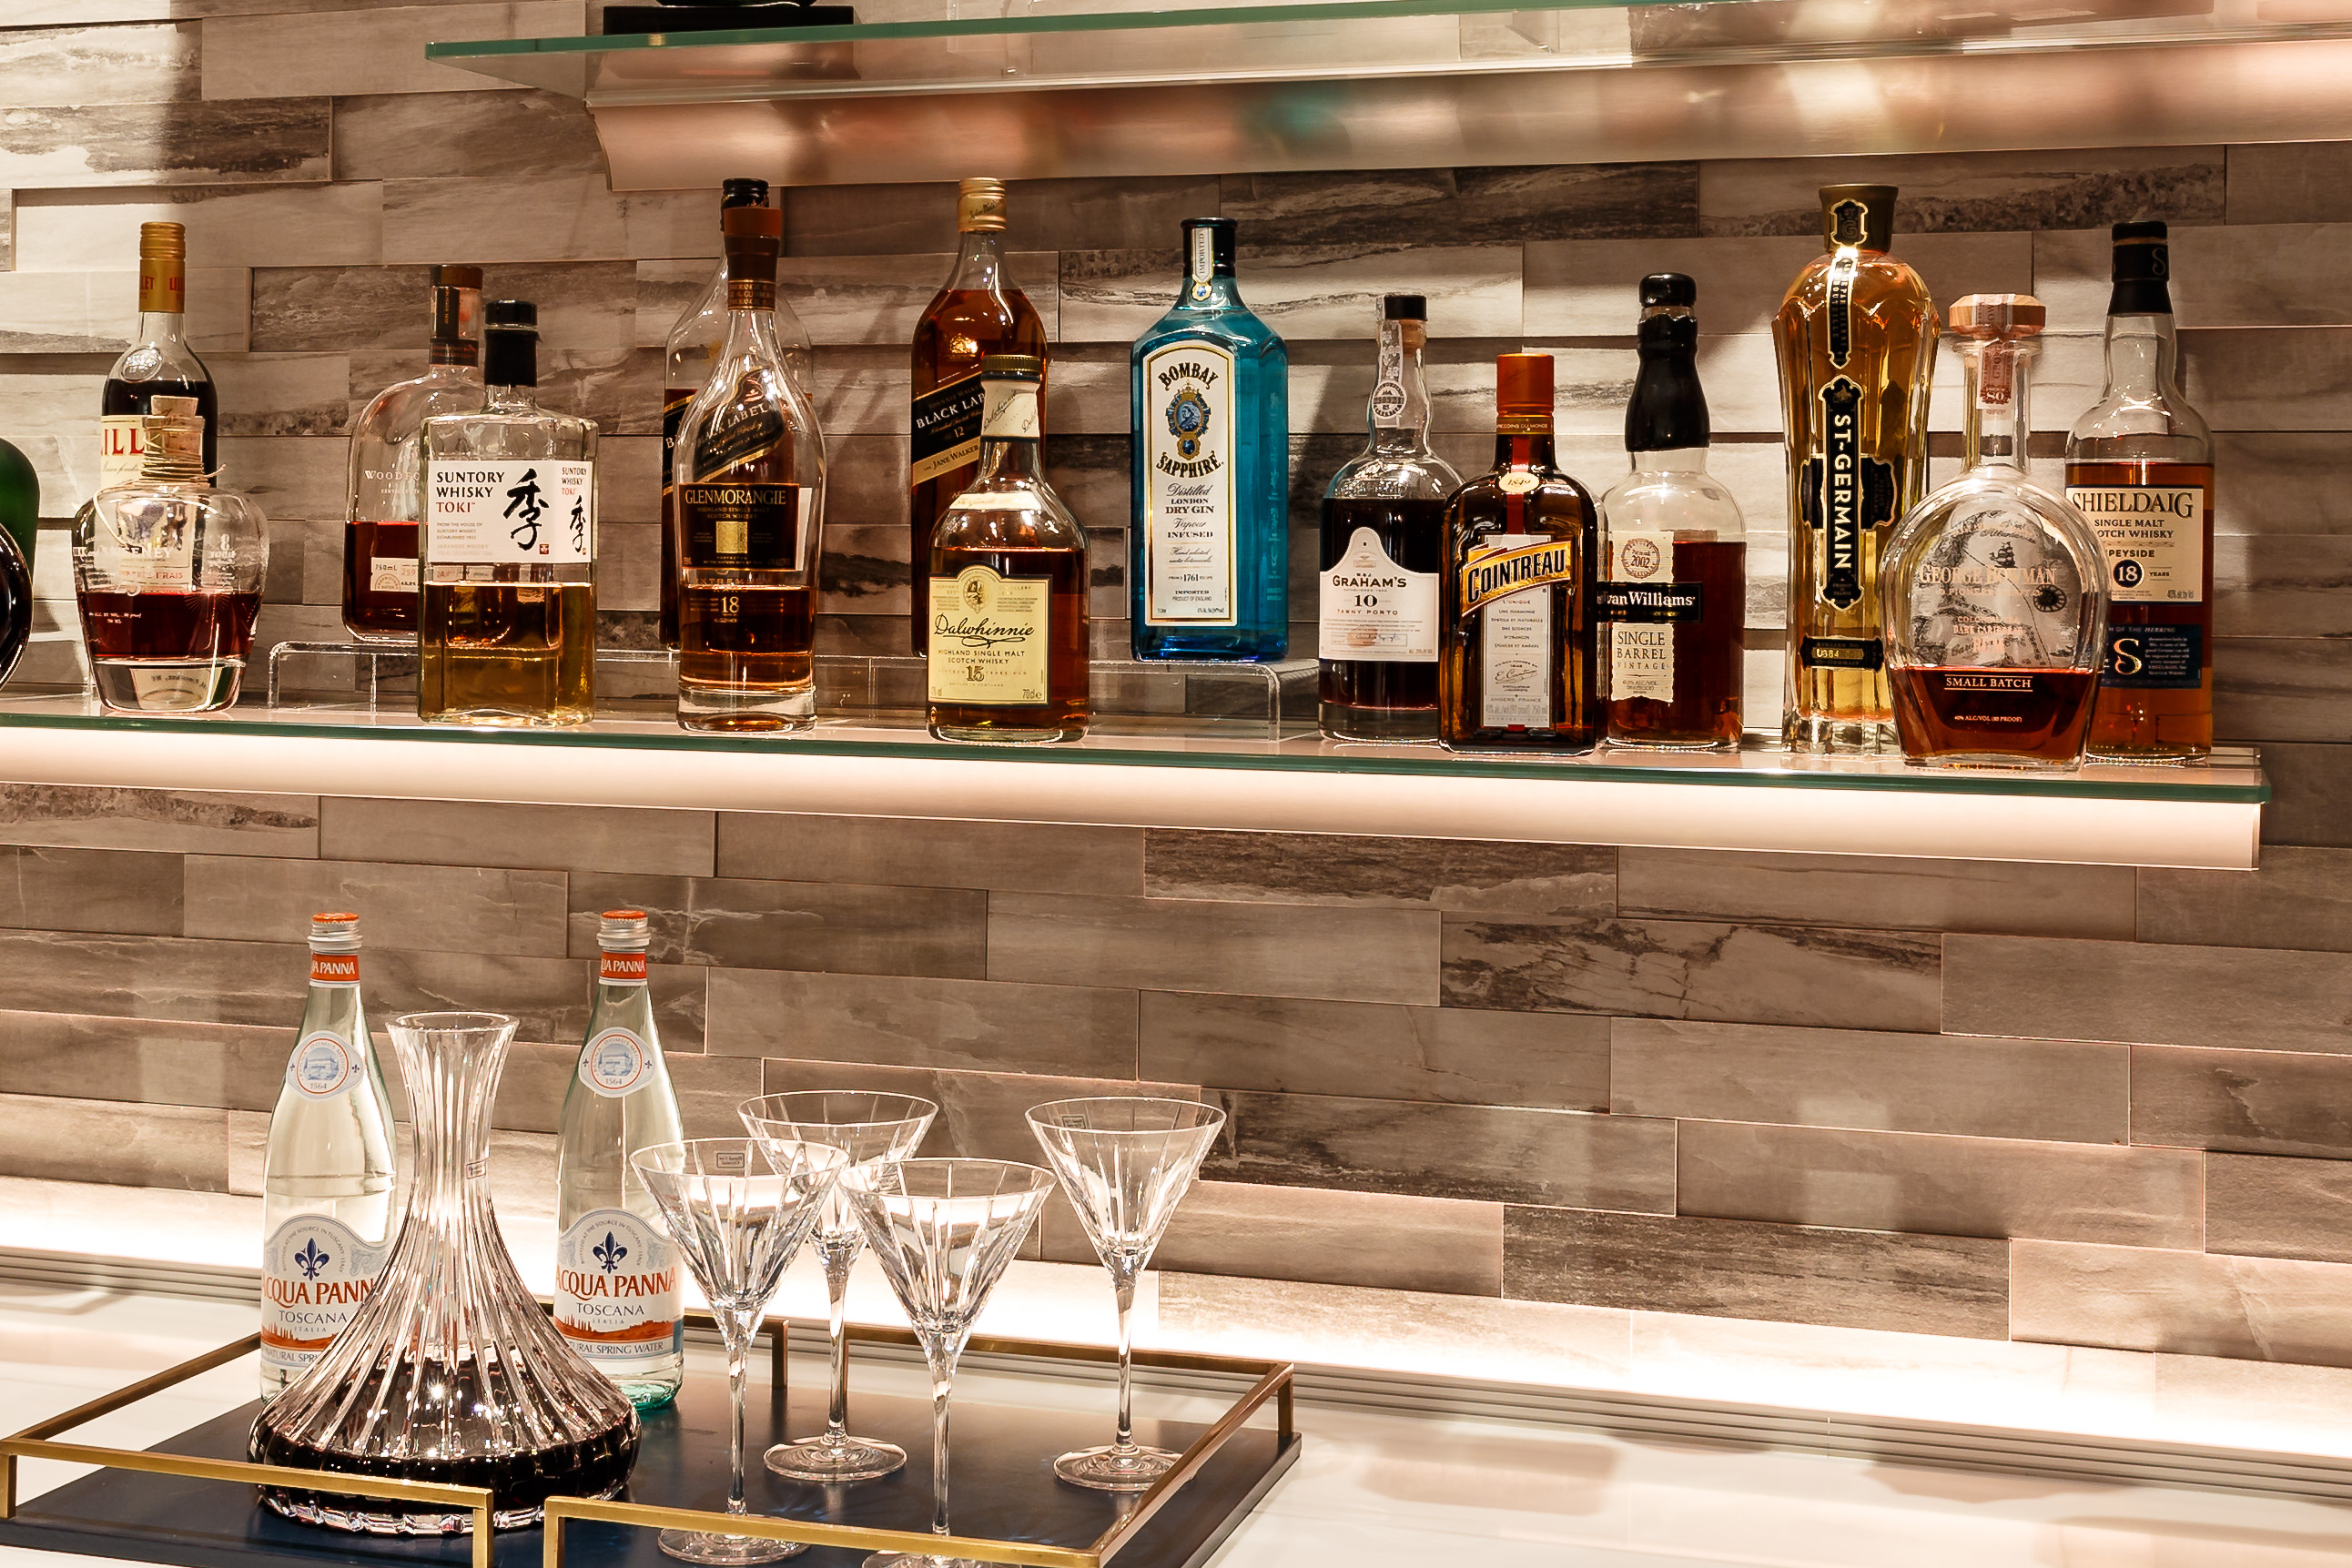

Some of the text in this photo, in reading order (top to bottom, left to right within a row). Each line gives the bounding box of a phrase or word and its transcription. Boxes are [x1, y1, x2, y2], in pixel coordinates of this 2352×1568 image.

[1198, 232, 1206, 274] IMPORTED
[1157, 361, 1220, 392] BOMBAY
[1986, 391, 2005, 401] 80
[727, 402, 768, 429] LABEL
[916, 404, 958, 429] BLACK
[954, 426, 965, 438] 12
[100, 425, 146, 456] ILL
[932, 444, 979, 470] JANE WALKER
[1155, 450, 1222, 479] SAPPHIRE
[436, 471, 505, 483] SUNTORY
[561, 466, 588, 476] SUNTORY
[561, 477, 583, 486] WHISKY
[436, 486, 493, 498] WHISKY
[1166, 482, 1214, 497] Distilled
[684, 490, 787, 505] GLENMORANGIE
[503, 468, 550, 551] 季
[1165, 505, 1215, 514] DRY GIN
[569, 495, 587, 553] 季
[2093, 519, 2165, 528] SINGLE MALT
[2128, 530, 2175, 539] WHISKY
[2106, 549, 2155, 558] PEYSIDE
[1630, 554, 1651, 569] 2002
[1183, 573, 1199, 582] 1761
[1332, 574, 1407, 588] GRAHAM'S
[1466, 548, 1566, 605] COINTREAU
[2117, 565, 2139, 582] 18
[721, 596, 740, 613] 18
[1354, 594, 1378, 608] 10
[1627, 591, 1695, 608] Williams
[933, 612, 1036, 637] Dalwhinnie
[1617, 631, 1666, 646] SINGLE
[1617, 647, 1667, 660] BARREL
[2113, 637, 2143, 675] S
[966, 664, 985, 683] 15
[1617, 662, 1667, 671] VINTAGE
[1945, 677, 2032, 688] SMALL BATCH
[319, 960, 356, 975] PANNA
[612, 959, 646, 974] PANNA
[555, 1264, 677, 1301] ACQUA PANNA
[575, 1301, 645, 1317] TOSCANA
[279, 1310, 349, 1325] TOSCANA
[264, 1348, 297, 1362] NATURAL
[595, 1343, 632, 1355] SPRING
[634, 1340, 664, 1354] WATER
